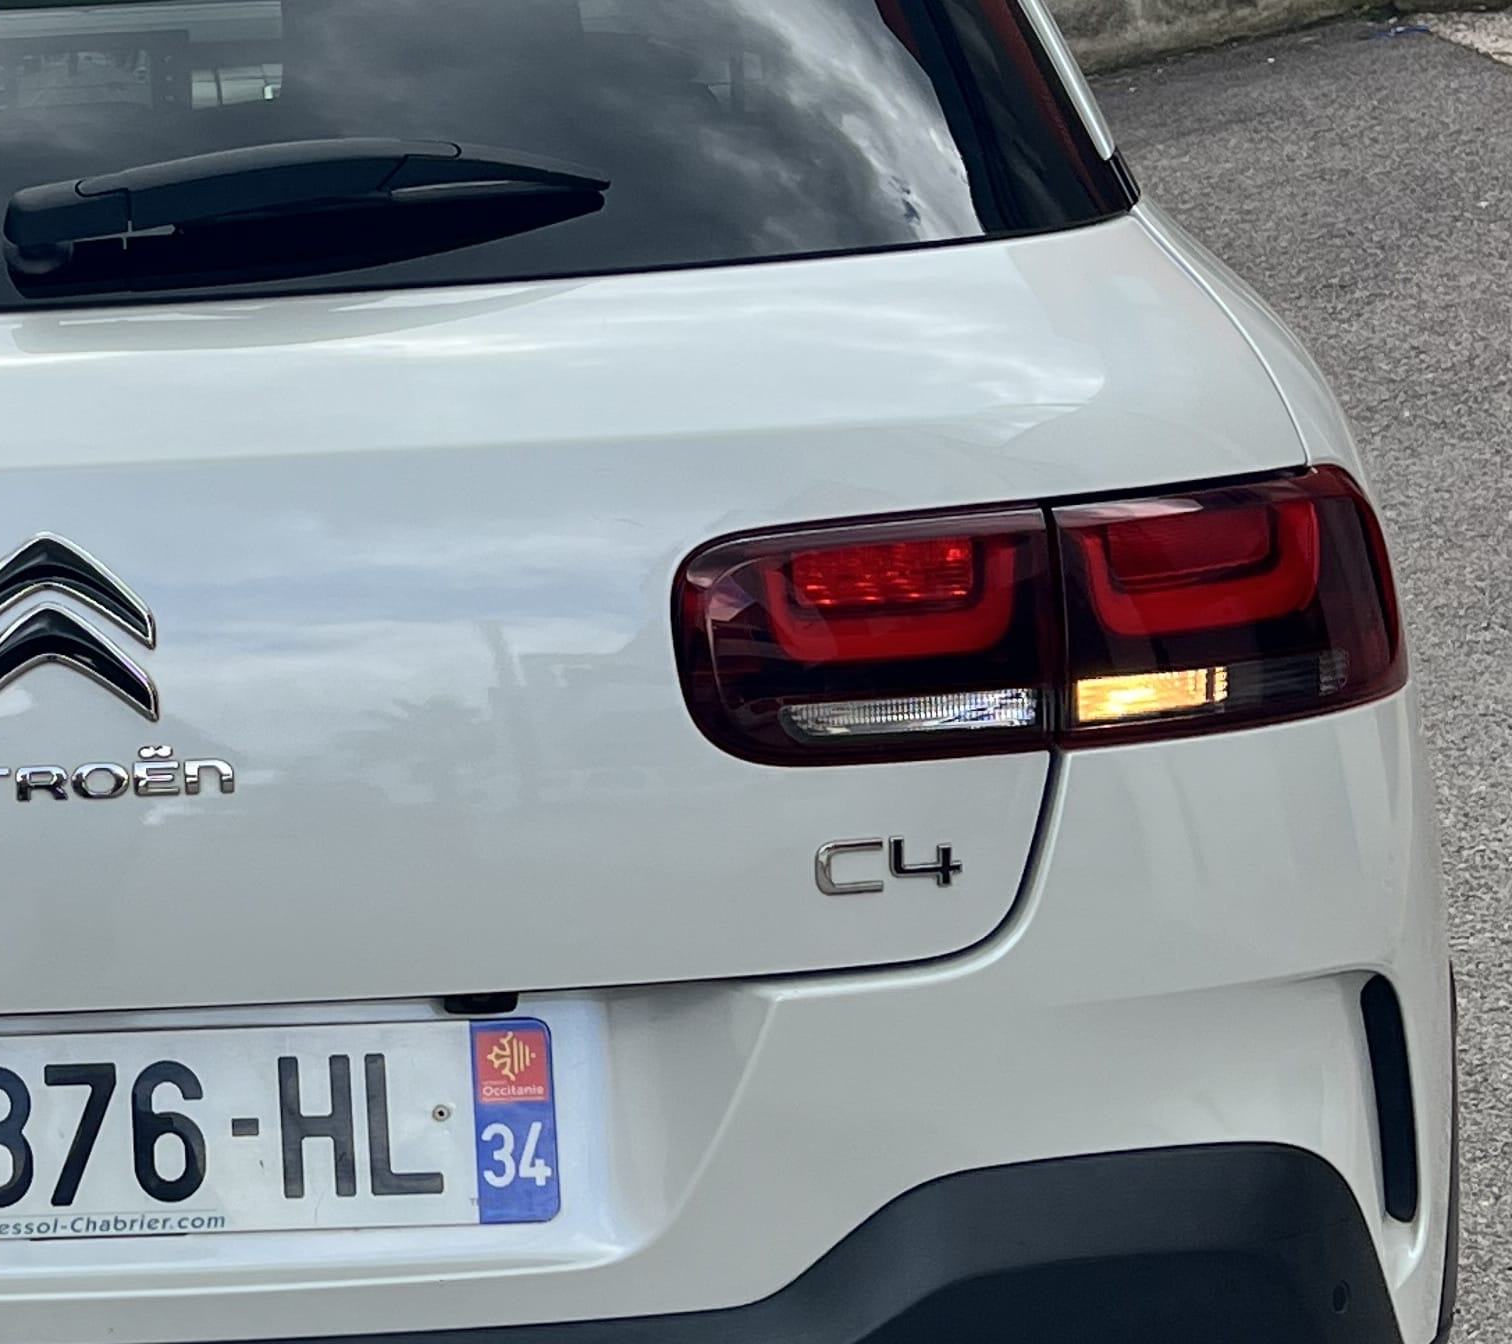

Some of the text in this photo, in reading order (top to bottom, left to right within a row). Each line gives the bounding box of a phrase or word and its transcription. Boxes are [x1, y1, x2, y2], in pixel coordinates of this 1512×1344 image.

[815, 836, 963, 896] C4
[482, 1084, 545, 1096] Occitanie
[481, 1121, 552, 1188] 34
